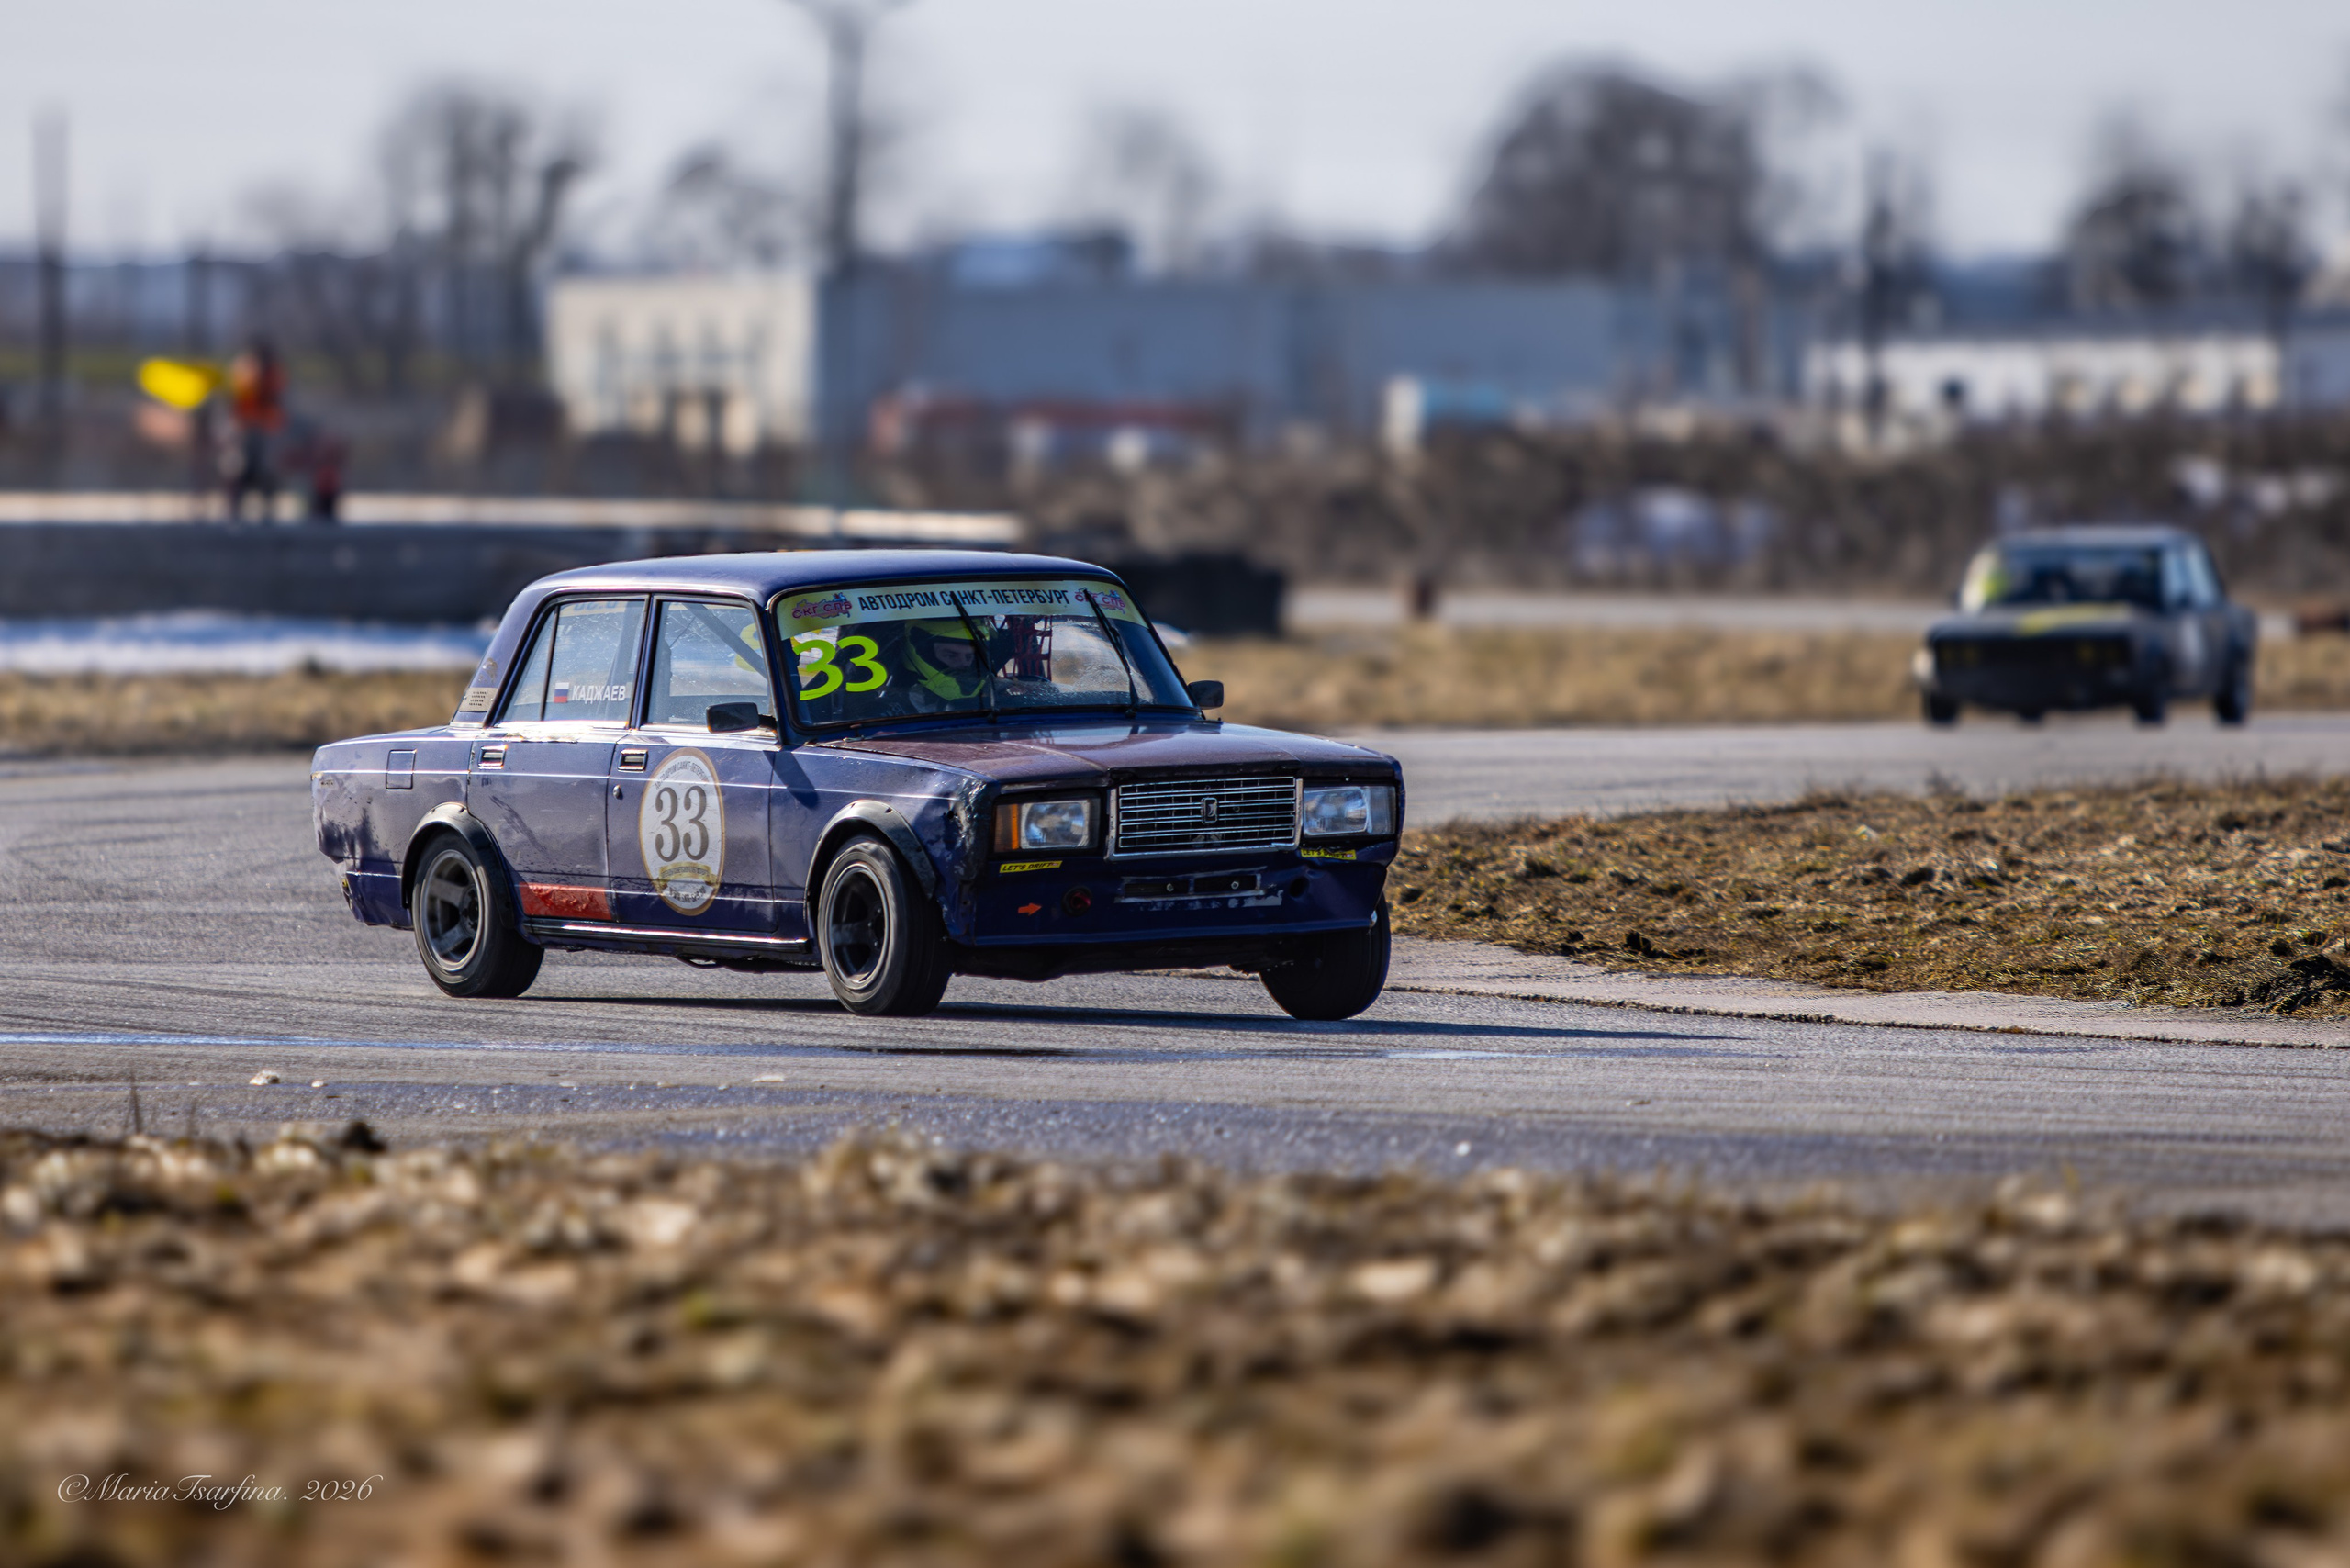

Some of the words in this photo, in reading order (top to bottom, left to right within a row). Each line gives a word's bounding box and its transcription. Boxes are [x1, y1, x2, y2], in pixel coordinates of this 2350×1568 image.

[822, 600, 853, 612] СПБ
[857, 590, 940, 611] АВТОДРОМ
[792, 635, 888, 700] 33
[572, 685, 626, 704] КАДЖАЕВ
[655, 785, 710, 863] 33
